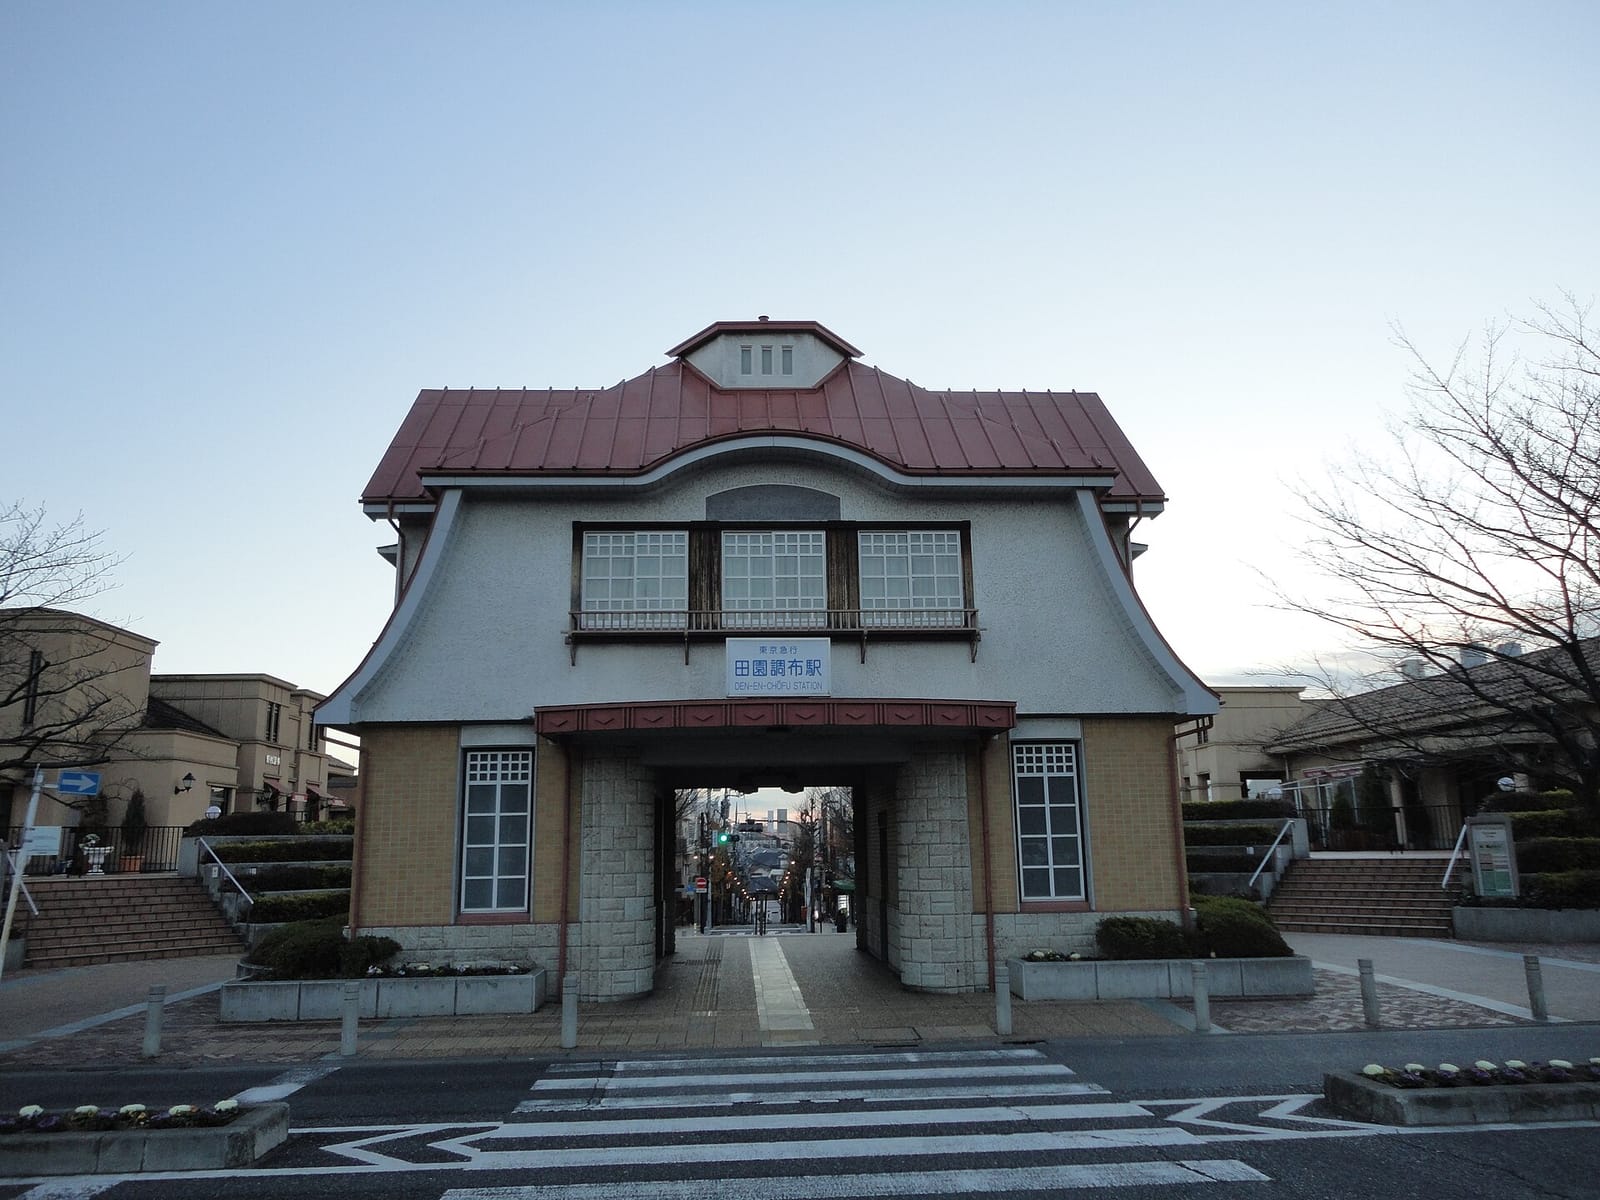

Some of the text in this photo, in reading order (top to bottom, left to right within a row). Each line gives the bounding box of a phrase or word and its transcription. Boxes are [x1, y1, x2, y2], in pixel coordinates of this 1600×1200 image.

[759, 646, 798, 654] 東京急行
[735, 659, 822, 676] 田園調布駅
[793, 681, 822, 690] STATION
